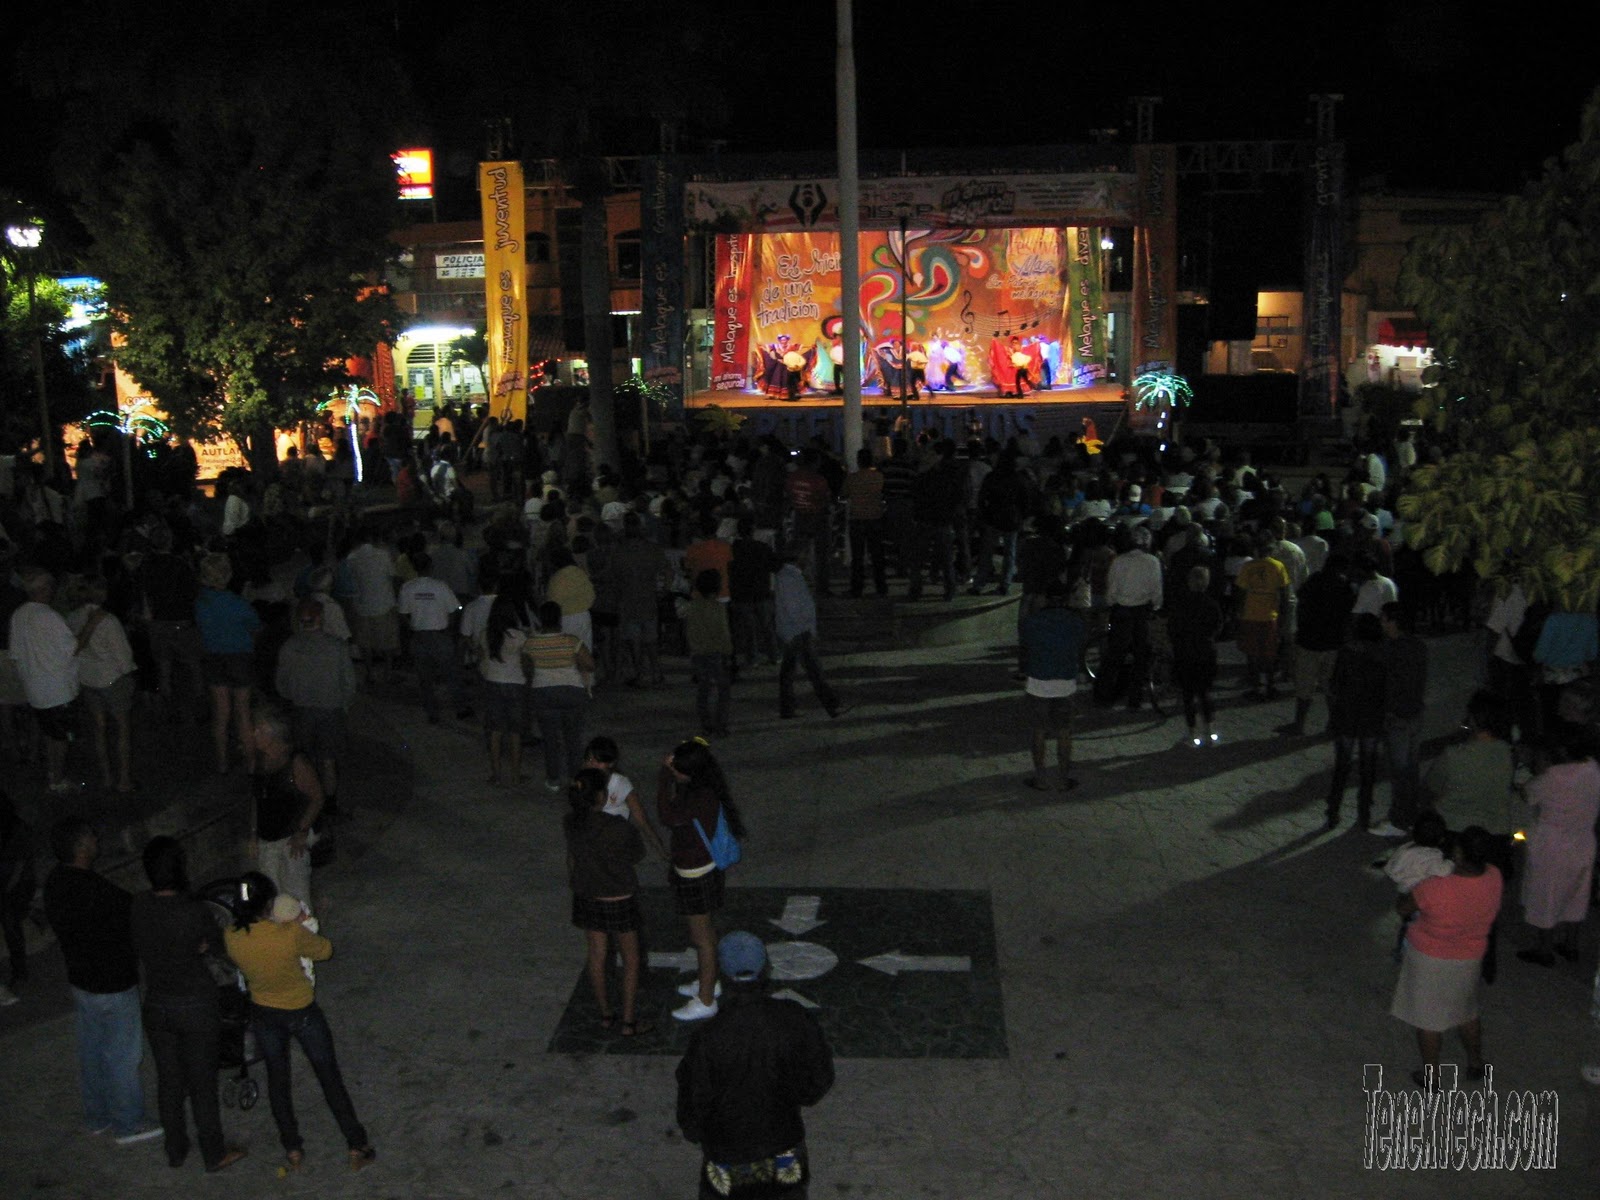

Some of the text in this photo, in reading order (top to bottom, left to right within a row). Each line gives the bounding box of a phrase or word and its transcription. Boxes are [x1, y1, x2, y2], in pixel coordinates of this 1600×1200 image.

[487, 167, 520, 253] juventud
[442, 256, 484, 264] POLICIA
[654, 262, 667, 281] es
[777, 248, 842, 280] El Inici
[498, 271, 512, 291] es
[762, 277, 814, 304] de una
[1079, 279, 1090, 296] es
[726, 288, 738, 303] es
[756, 296, 820, 329] tradición
[720, 308, 743, 364] Melaque
[1078, 300, 1098, 358] Melaque
